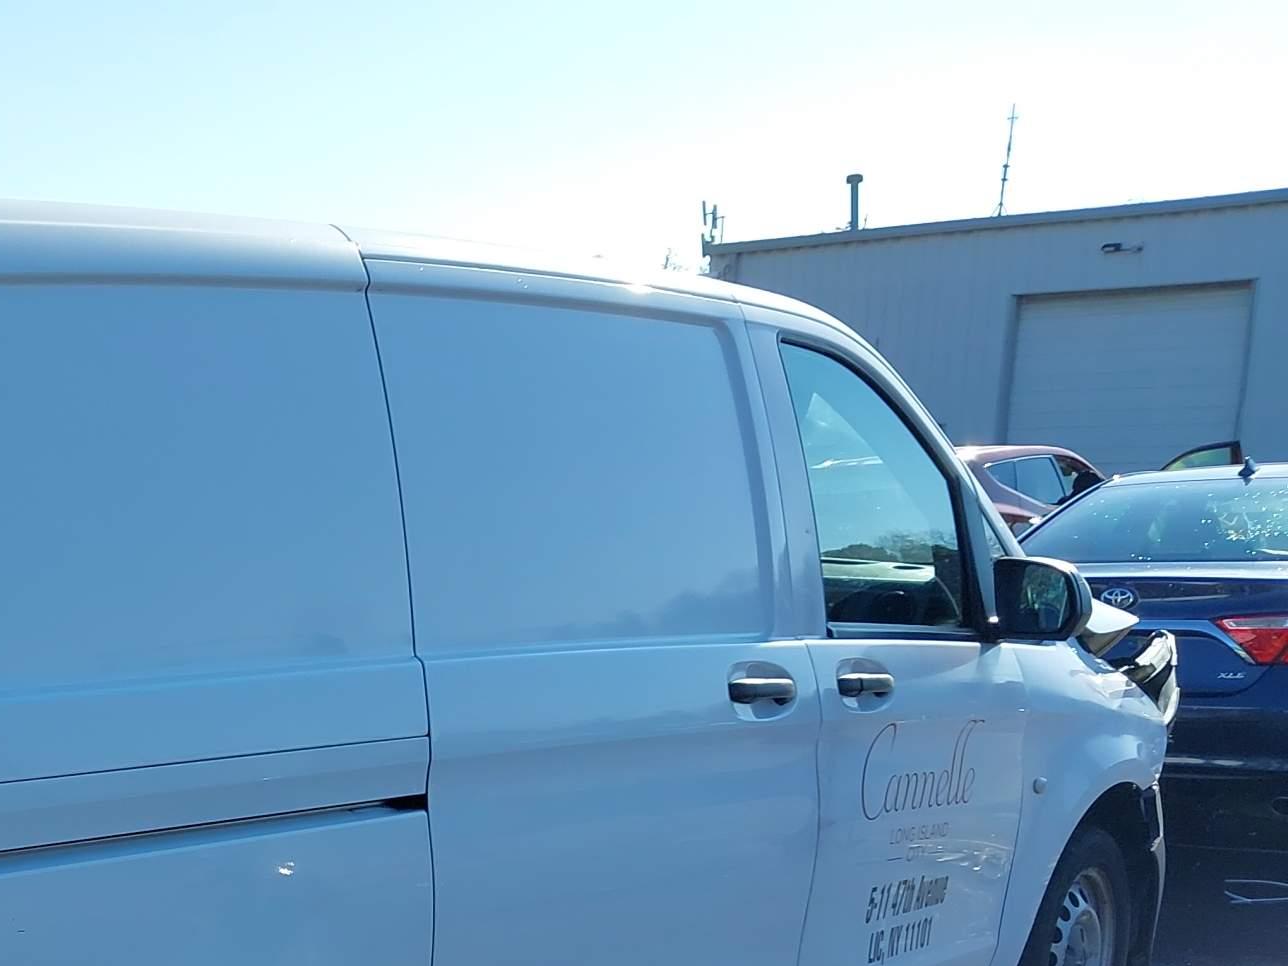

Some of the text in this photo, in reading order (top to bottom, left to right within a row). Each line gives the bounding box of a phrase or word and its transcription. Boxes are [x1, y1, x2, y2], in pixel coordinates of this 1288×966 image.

[861, 719, 985, 821] Cannelle
[917, 821, 950, 841] ISLAND
[865, 875, 949, 924] 5-11 47th Avenue
[887, 927, 906, 957] NY
[904, 917, 933, 954] 11101
